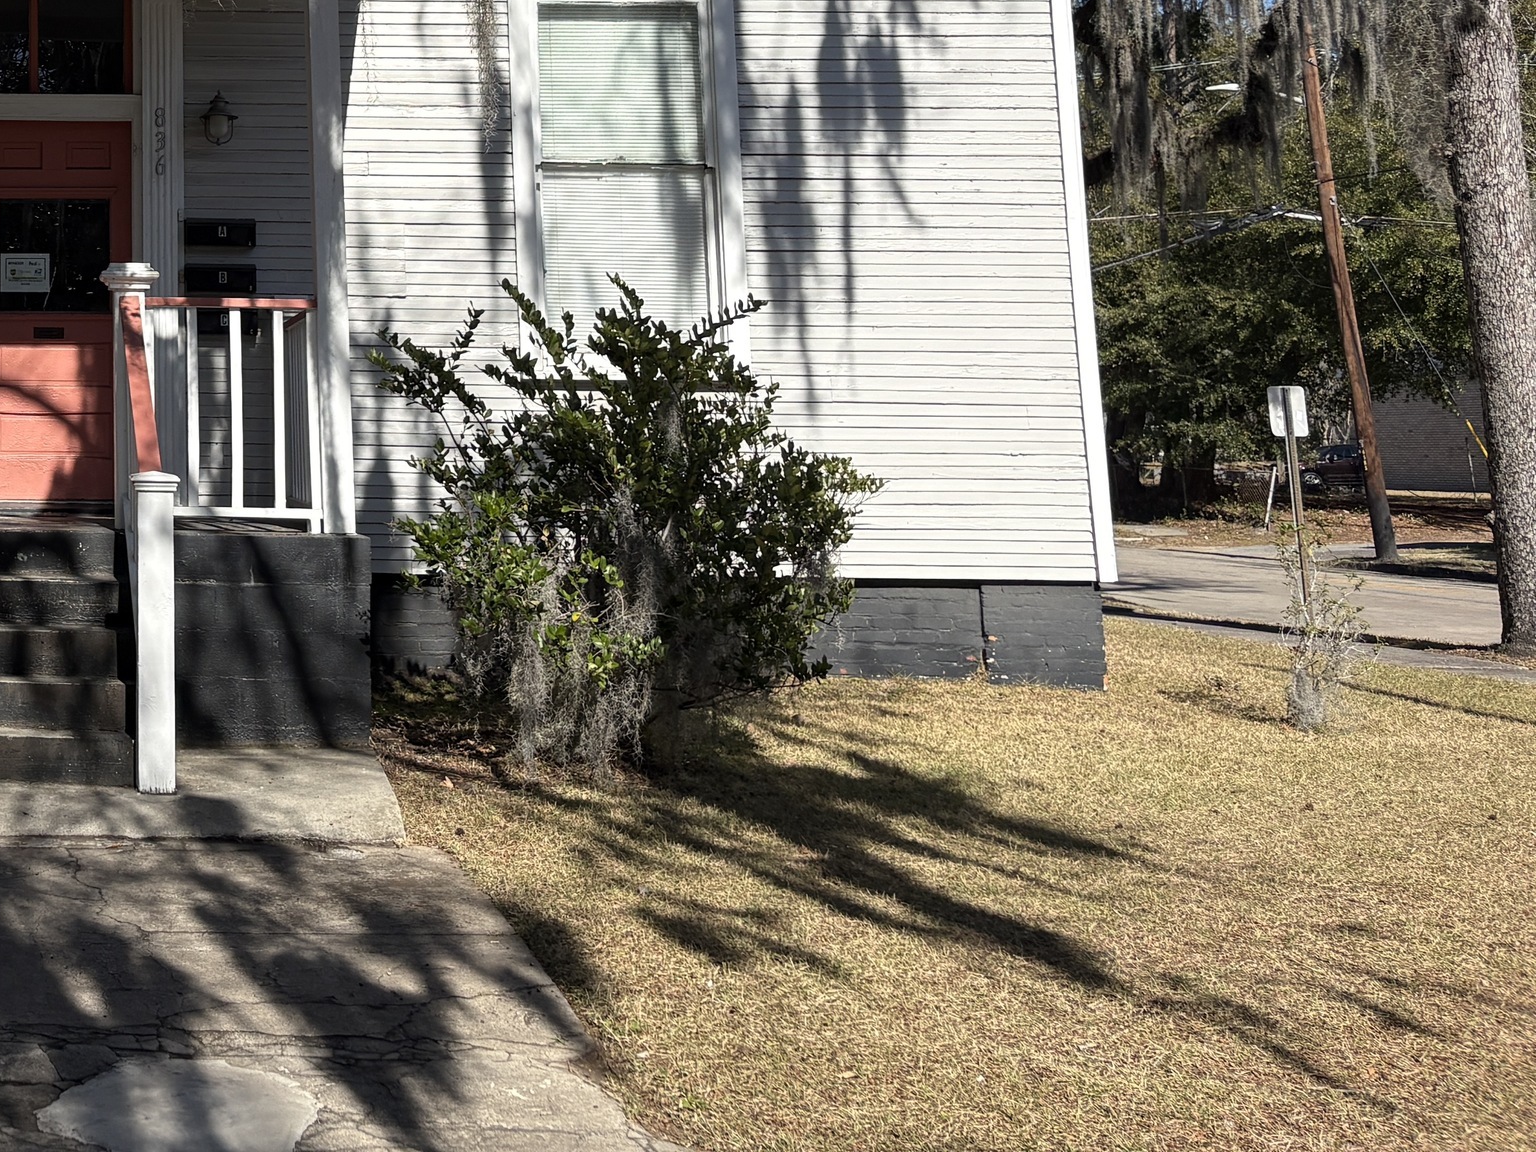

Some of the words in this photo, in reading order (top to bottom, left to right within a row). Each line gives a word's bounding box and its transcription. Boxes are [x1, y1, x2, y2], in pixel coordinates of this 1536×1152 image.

[155, 107, 166, 176] 836
[219, 226, 226, 236] A
[220, 272, 227, 283] B
[221, 314, 227, 326] C
